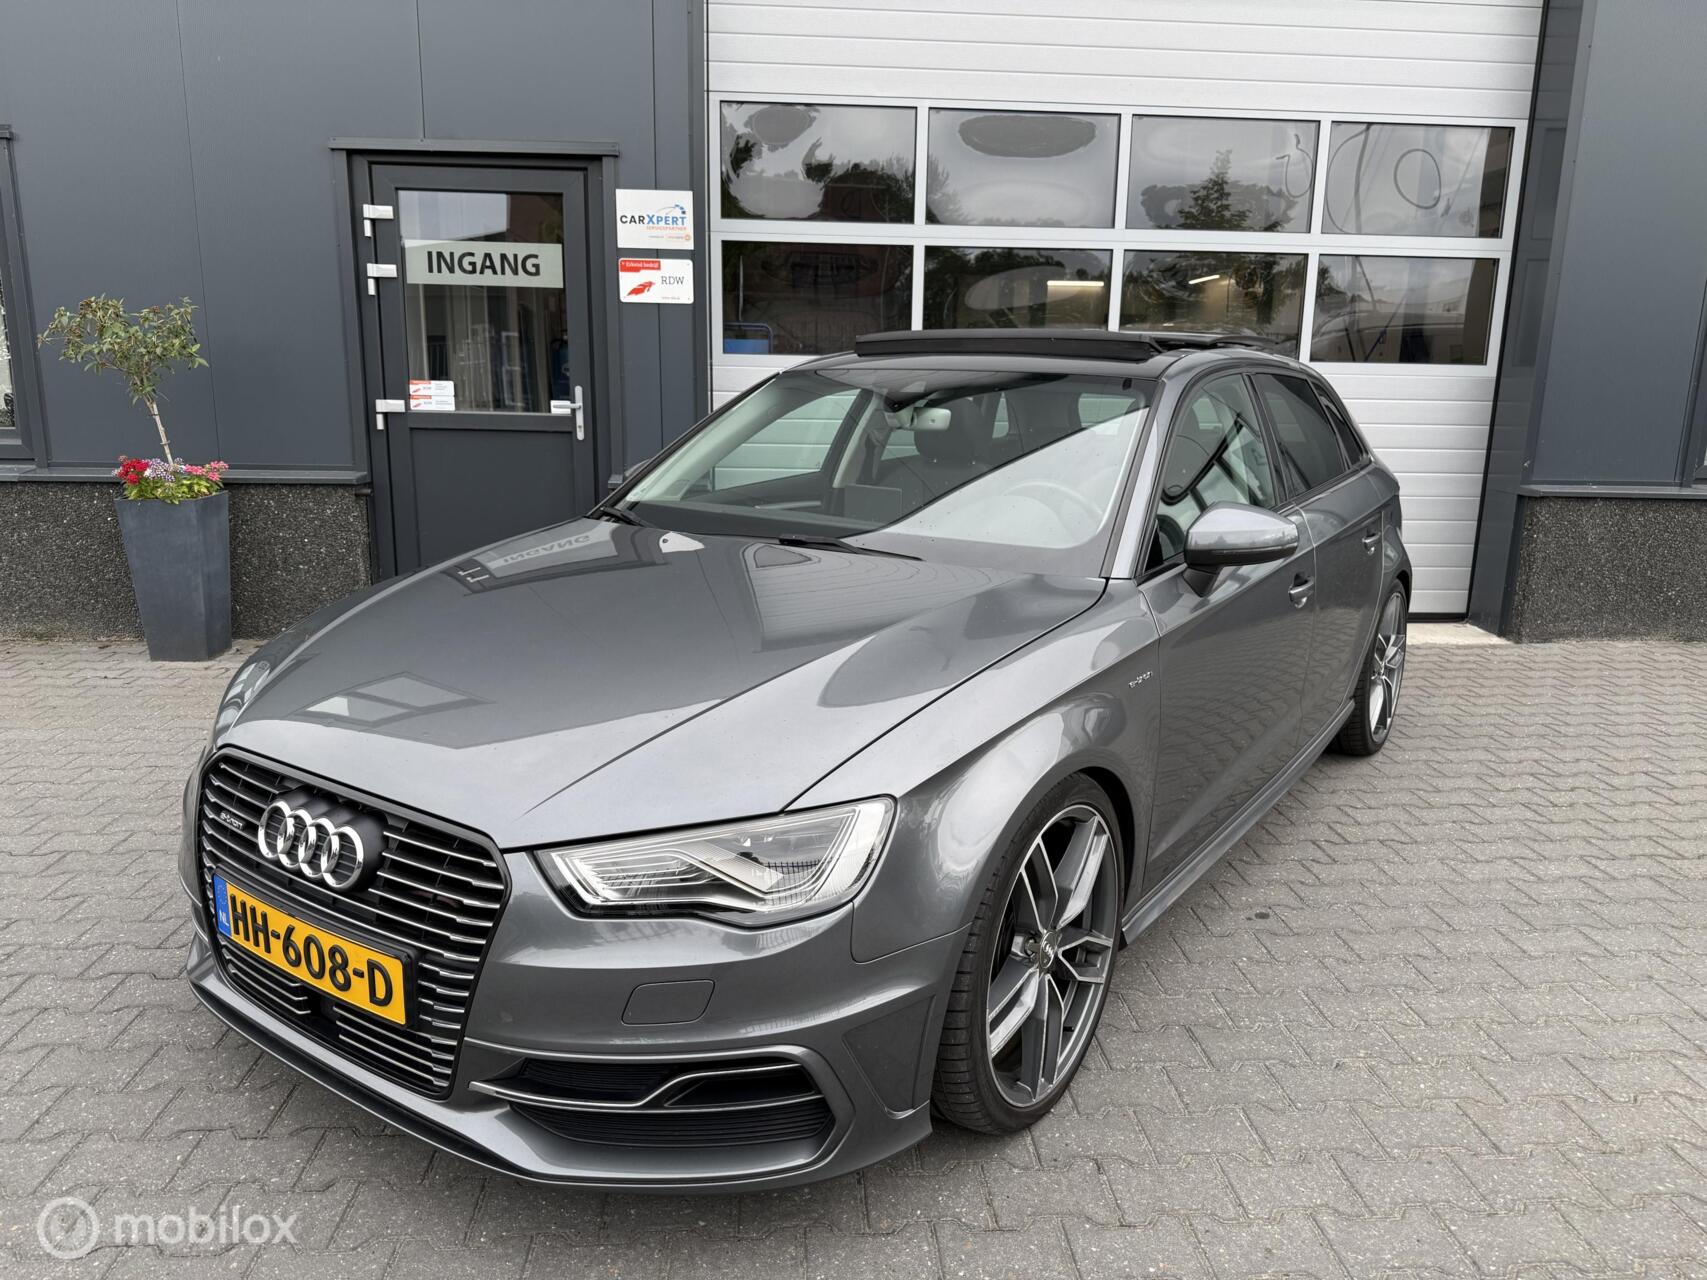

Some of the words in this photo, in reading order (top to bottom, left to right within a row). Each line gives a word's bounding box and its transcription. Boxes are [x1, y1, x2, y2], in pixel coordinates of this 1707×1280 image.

[620, 214, 687, 226] CARXPERT
[427, 251, 541, 277] INGANG
[661, 275, 684, 285] RDW
[219, 911, 229, 927] NL
[230, 893, 393, 1007] HH-608-D
